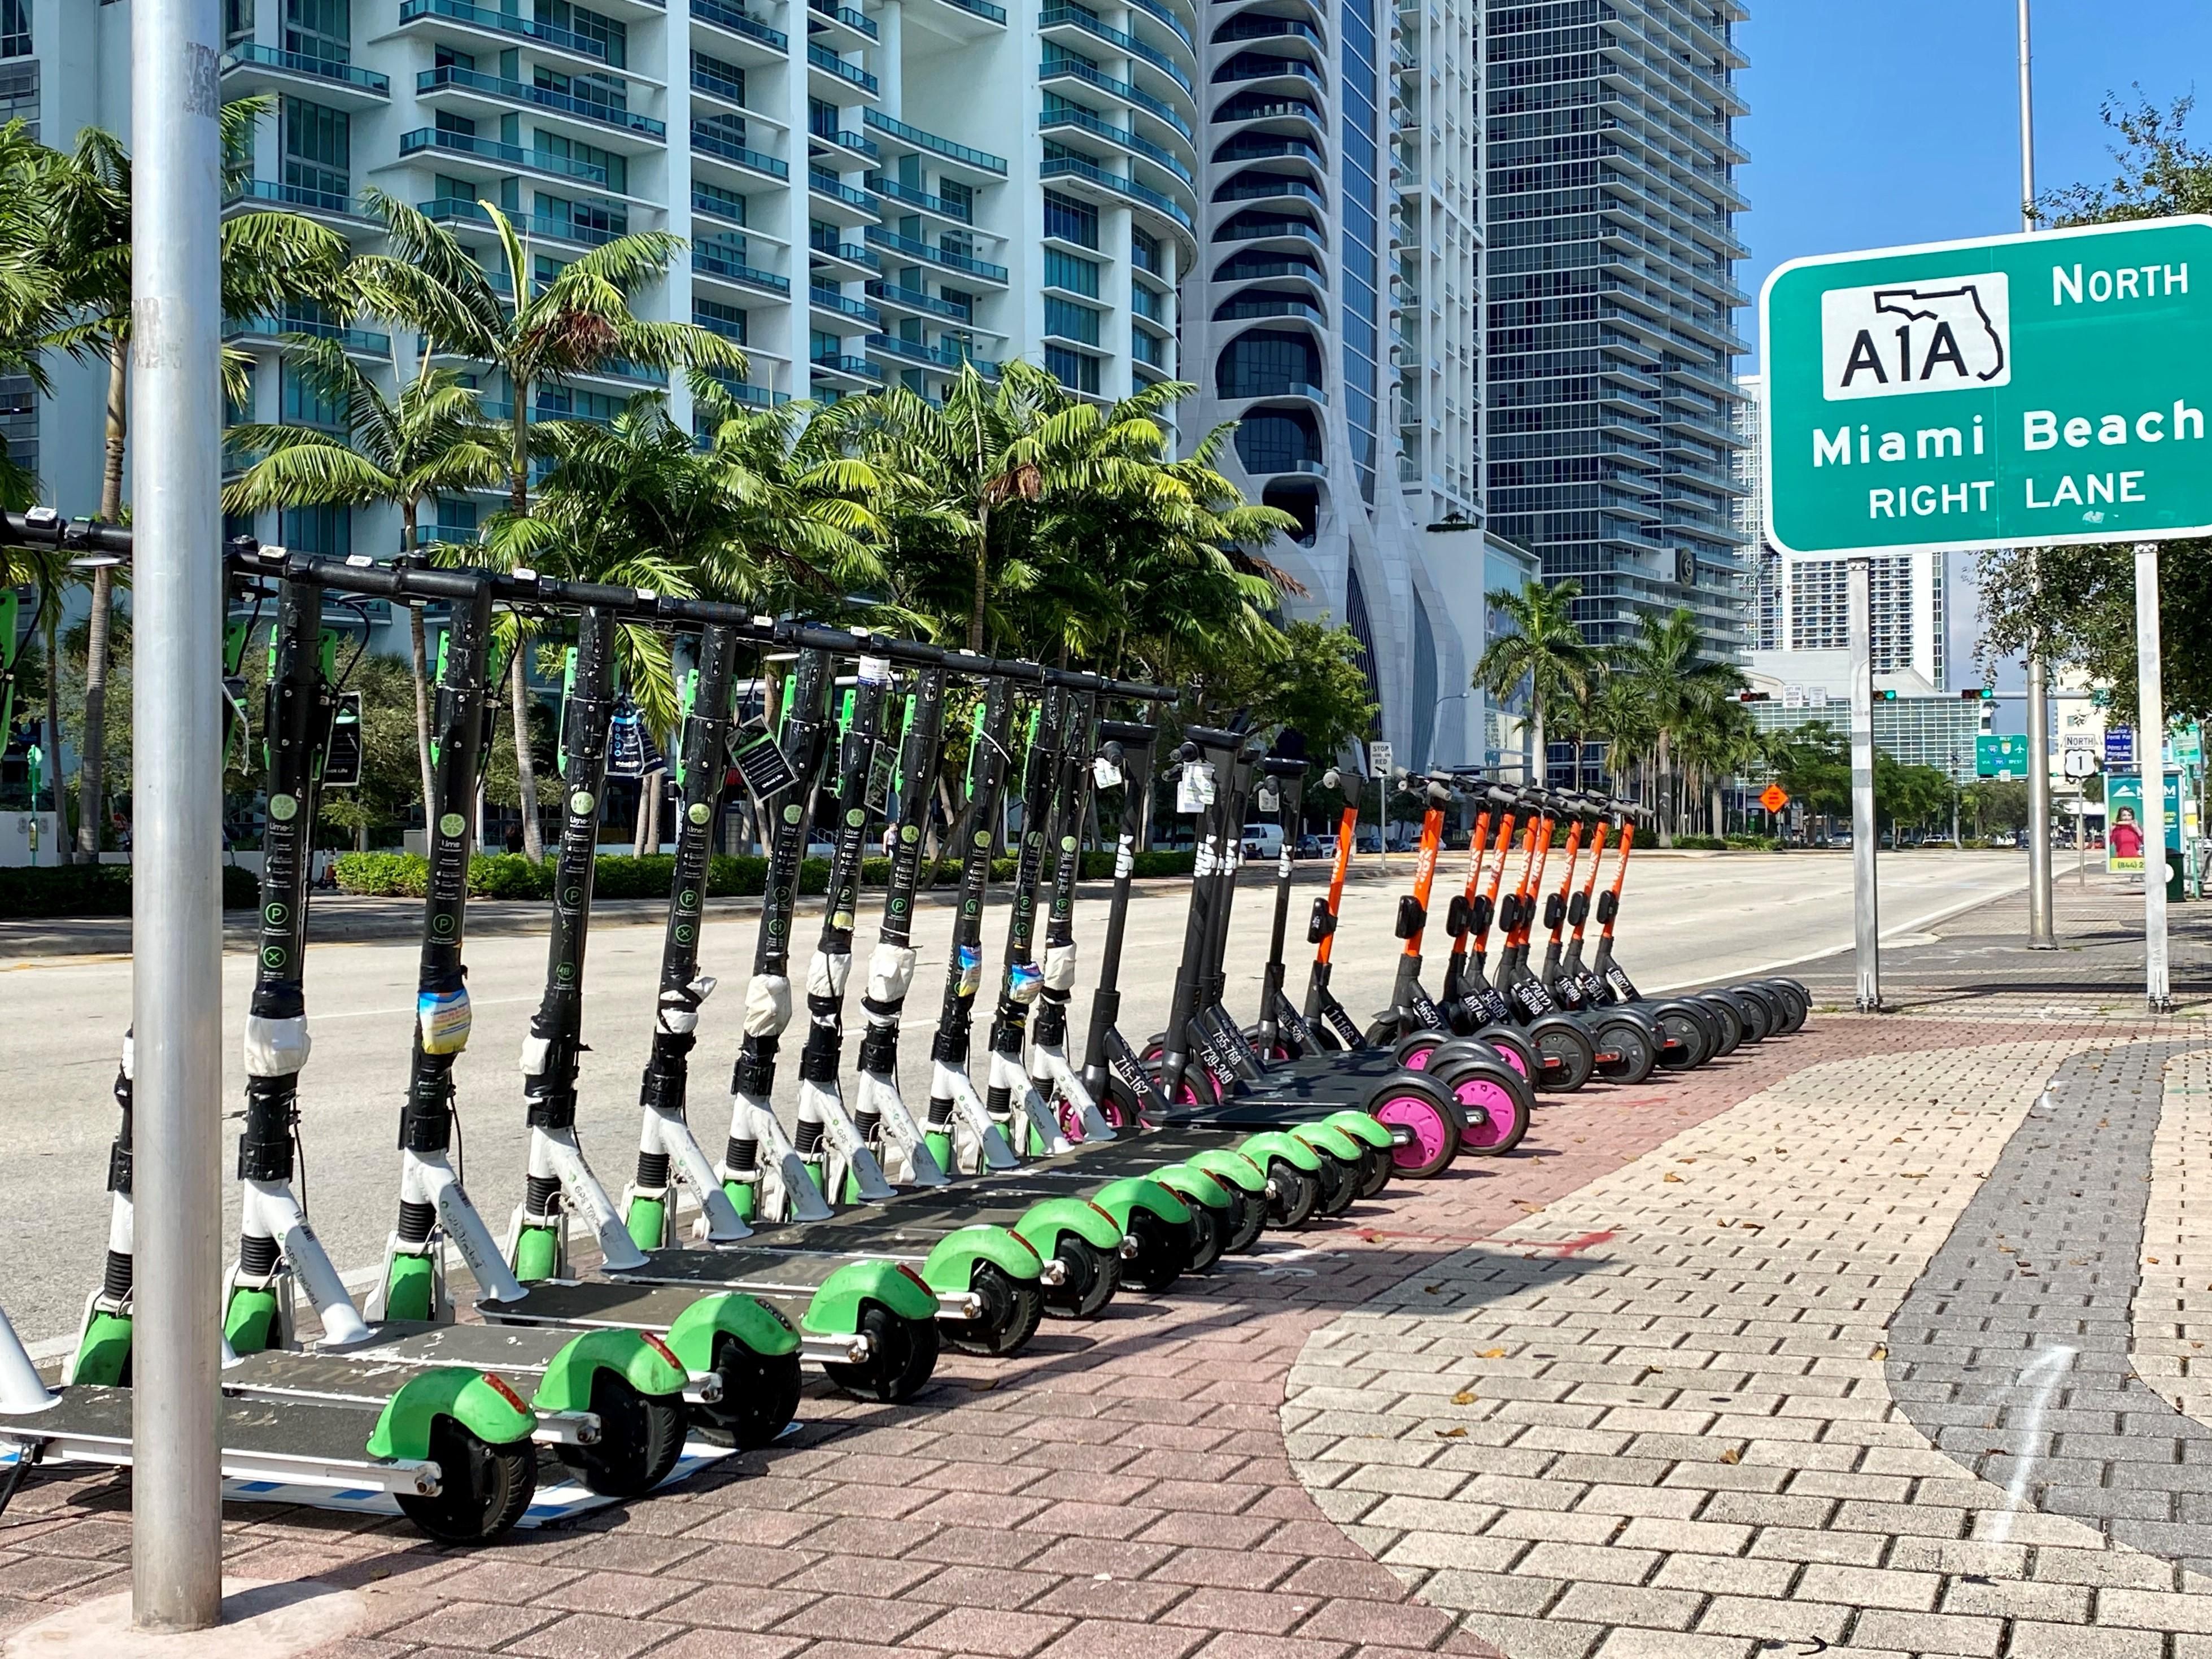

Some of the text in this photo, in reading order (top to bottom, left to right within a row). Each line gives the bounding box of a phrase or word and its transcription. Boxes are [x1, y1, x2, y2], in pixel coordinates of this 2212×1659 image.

[1840, 321, 1969, 387] A1A
[1812, 399, 2205, 468] Miami Beach
[1869, 470, 2146, 519] RIGHT LANE
[2067, 736, 2093, 745] NORTH
[2078, 756, 2083, 770] 1
[1416, 1000, 1442, 1030] 56521
[1464, 995, 1490, 1023] 48745
[1481, 989, 1508, 1019] 34509
[1518, 987, 1544, 1015] 56768
[1328, 1009, 1354, 1040] 11166
[1212, 1028, 1242, 1066] 755-768
[1115, 1054, 1149, 1097] 715-162
[1200, 1045, 1234, 1085] 739-349
[575, 1186, 588, 1204] GPS
[285, 1245, 319, 1306] GPS Tracked
